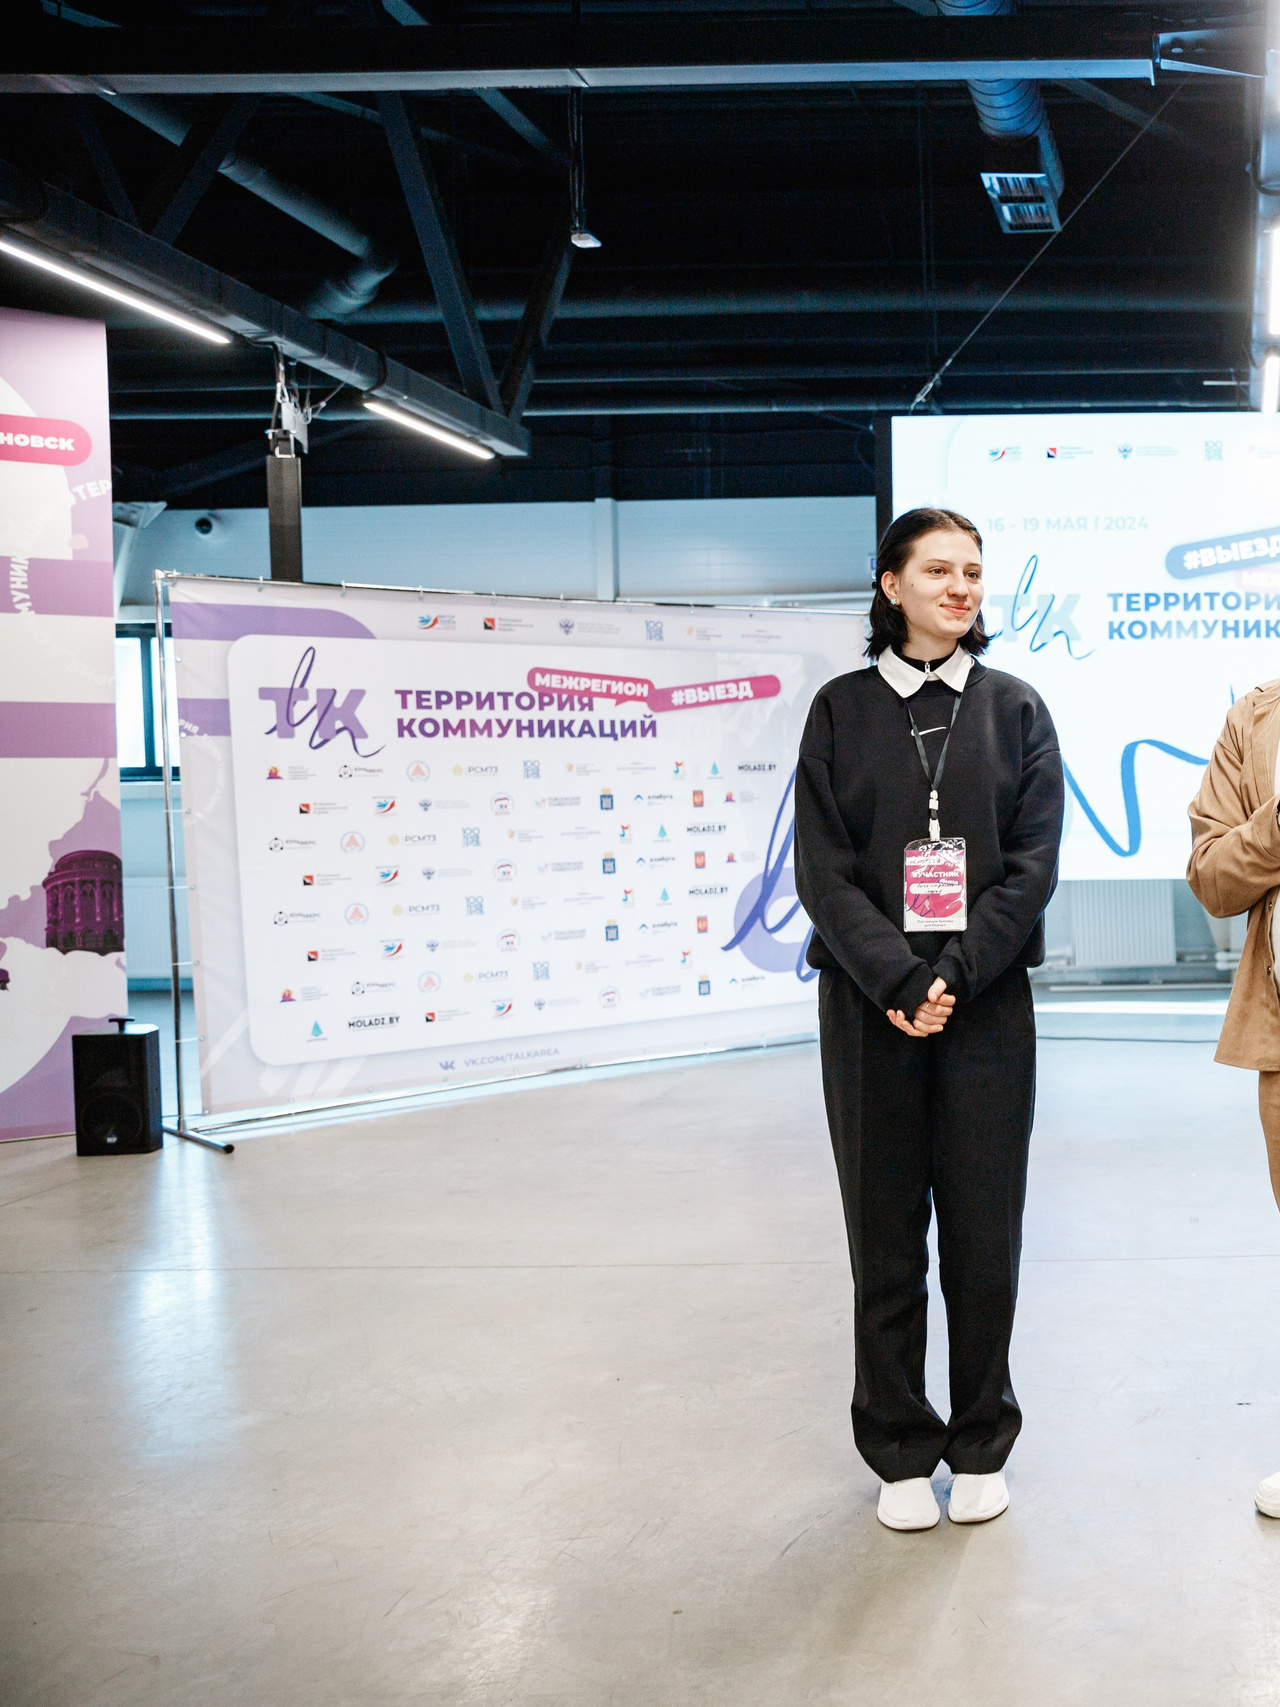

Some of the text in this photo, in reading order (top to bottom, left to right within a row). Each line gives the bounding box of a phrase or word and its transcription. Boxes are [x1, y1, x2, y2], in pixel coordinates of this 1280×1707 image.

[0, 431, 76, 452] НОВСК
[71, 479, 111, 502] ТЕР
[986, 517, 1005, 532] 16
[1022, 517, 1040, 531] 19
[1046, 516, 1088, 531] МАЯ
[1104, 515, 1149, 530] 2024
[534, 672, 649, 697] МЕЖРЕГИОН
[671, 681, 754, 706] #ВЫЕЗД
[395, 689, 595, 712] ТЕРРИТОРИЯ
[397, 714, 658, 741] КОММУНИКАЦИЙ
[348, 1016, 400, 1029] MOLADZ.BY
[464, 1048, 560, 1067] VK.COM/TALKAREA
